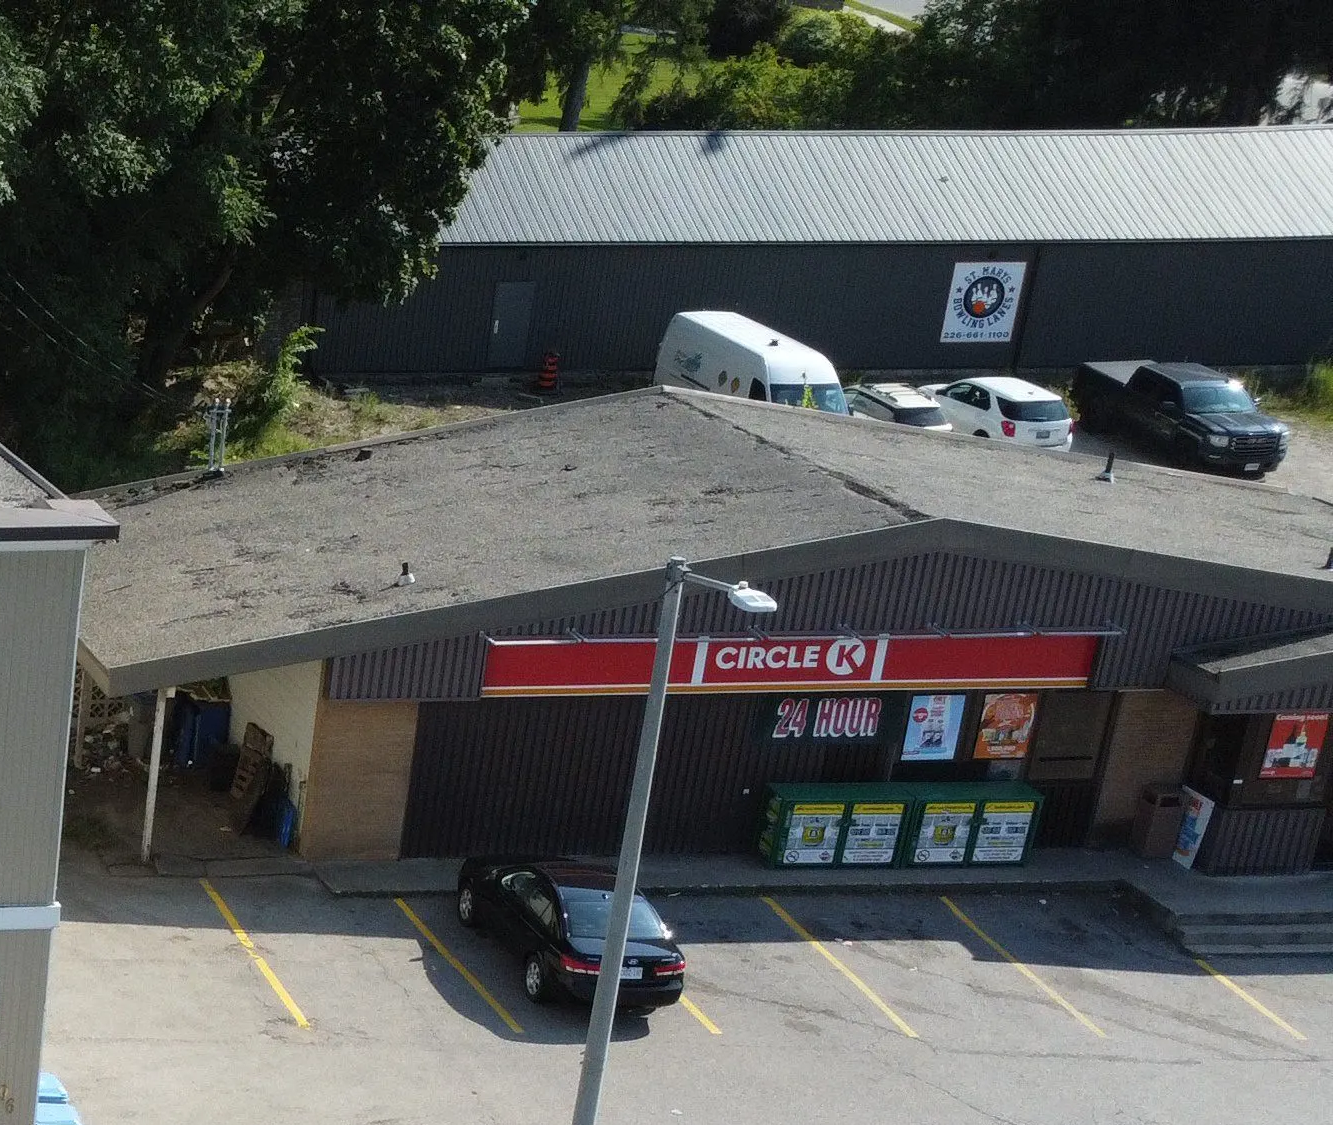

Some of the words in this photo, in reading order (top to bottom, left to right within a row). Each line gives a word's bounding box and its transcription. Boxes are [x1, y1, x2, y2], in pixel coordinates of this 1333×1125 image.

[953, 297, 985, 329] BOWLING
[987, 297, 1014, 327] LANES
[715, 646, 821, 670] CIRCLE
[772, 699, 809, 738] 24
[813, 698, 883, 738] HOUR
